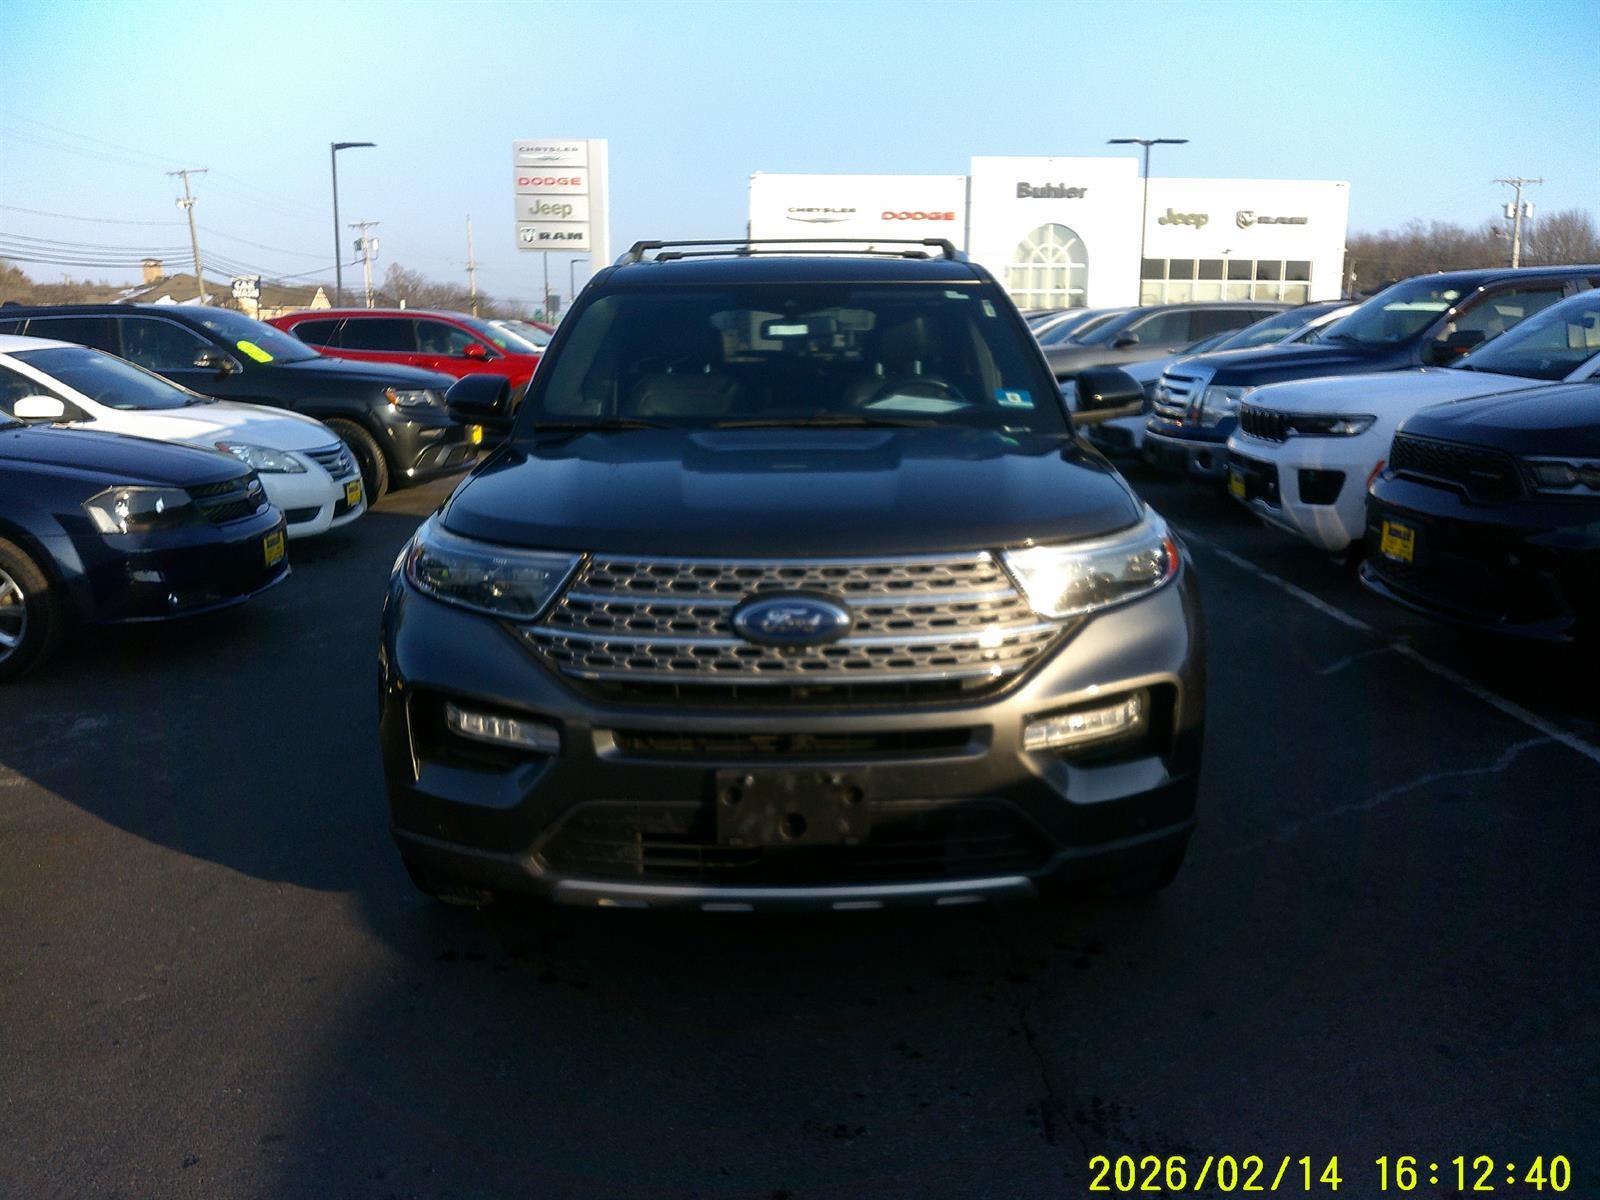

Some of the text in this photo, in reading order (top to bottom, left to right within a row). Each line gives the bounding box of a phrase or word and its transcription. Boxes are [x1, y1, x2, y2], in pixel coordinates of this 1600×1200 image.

[518, 177, 582, 186] DODGE
[528, 199, 573, 218] Jeep
[881, 211, 955, 221] DODGE
[1158, 208, 1209, 230] Jeep
[539, 232, 583, 240] RAM
